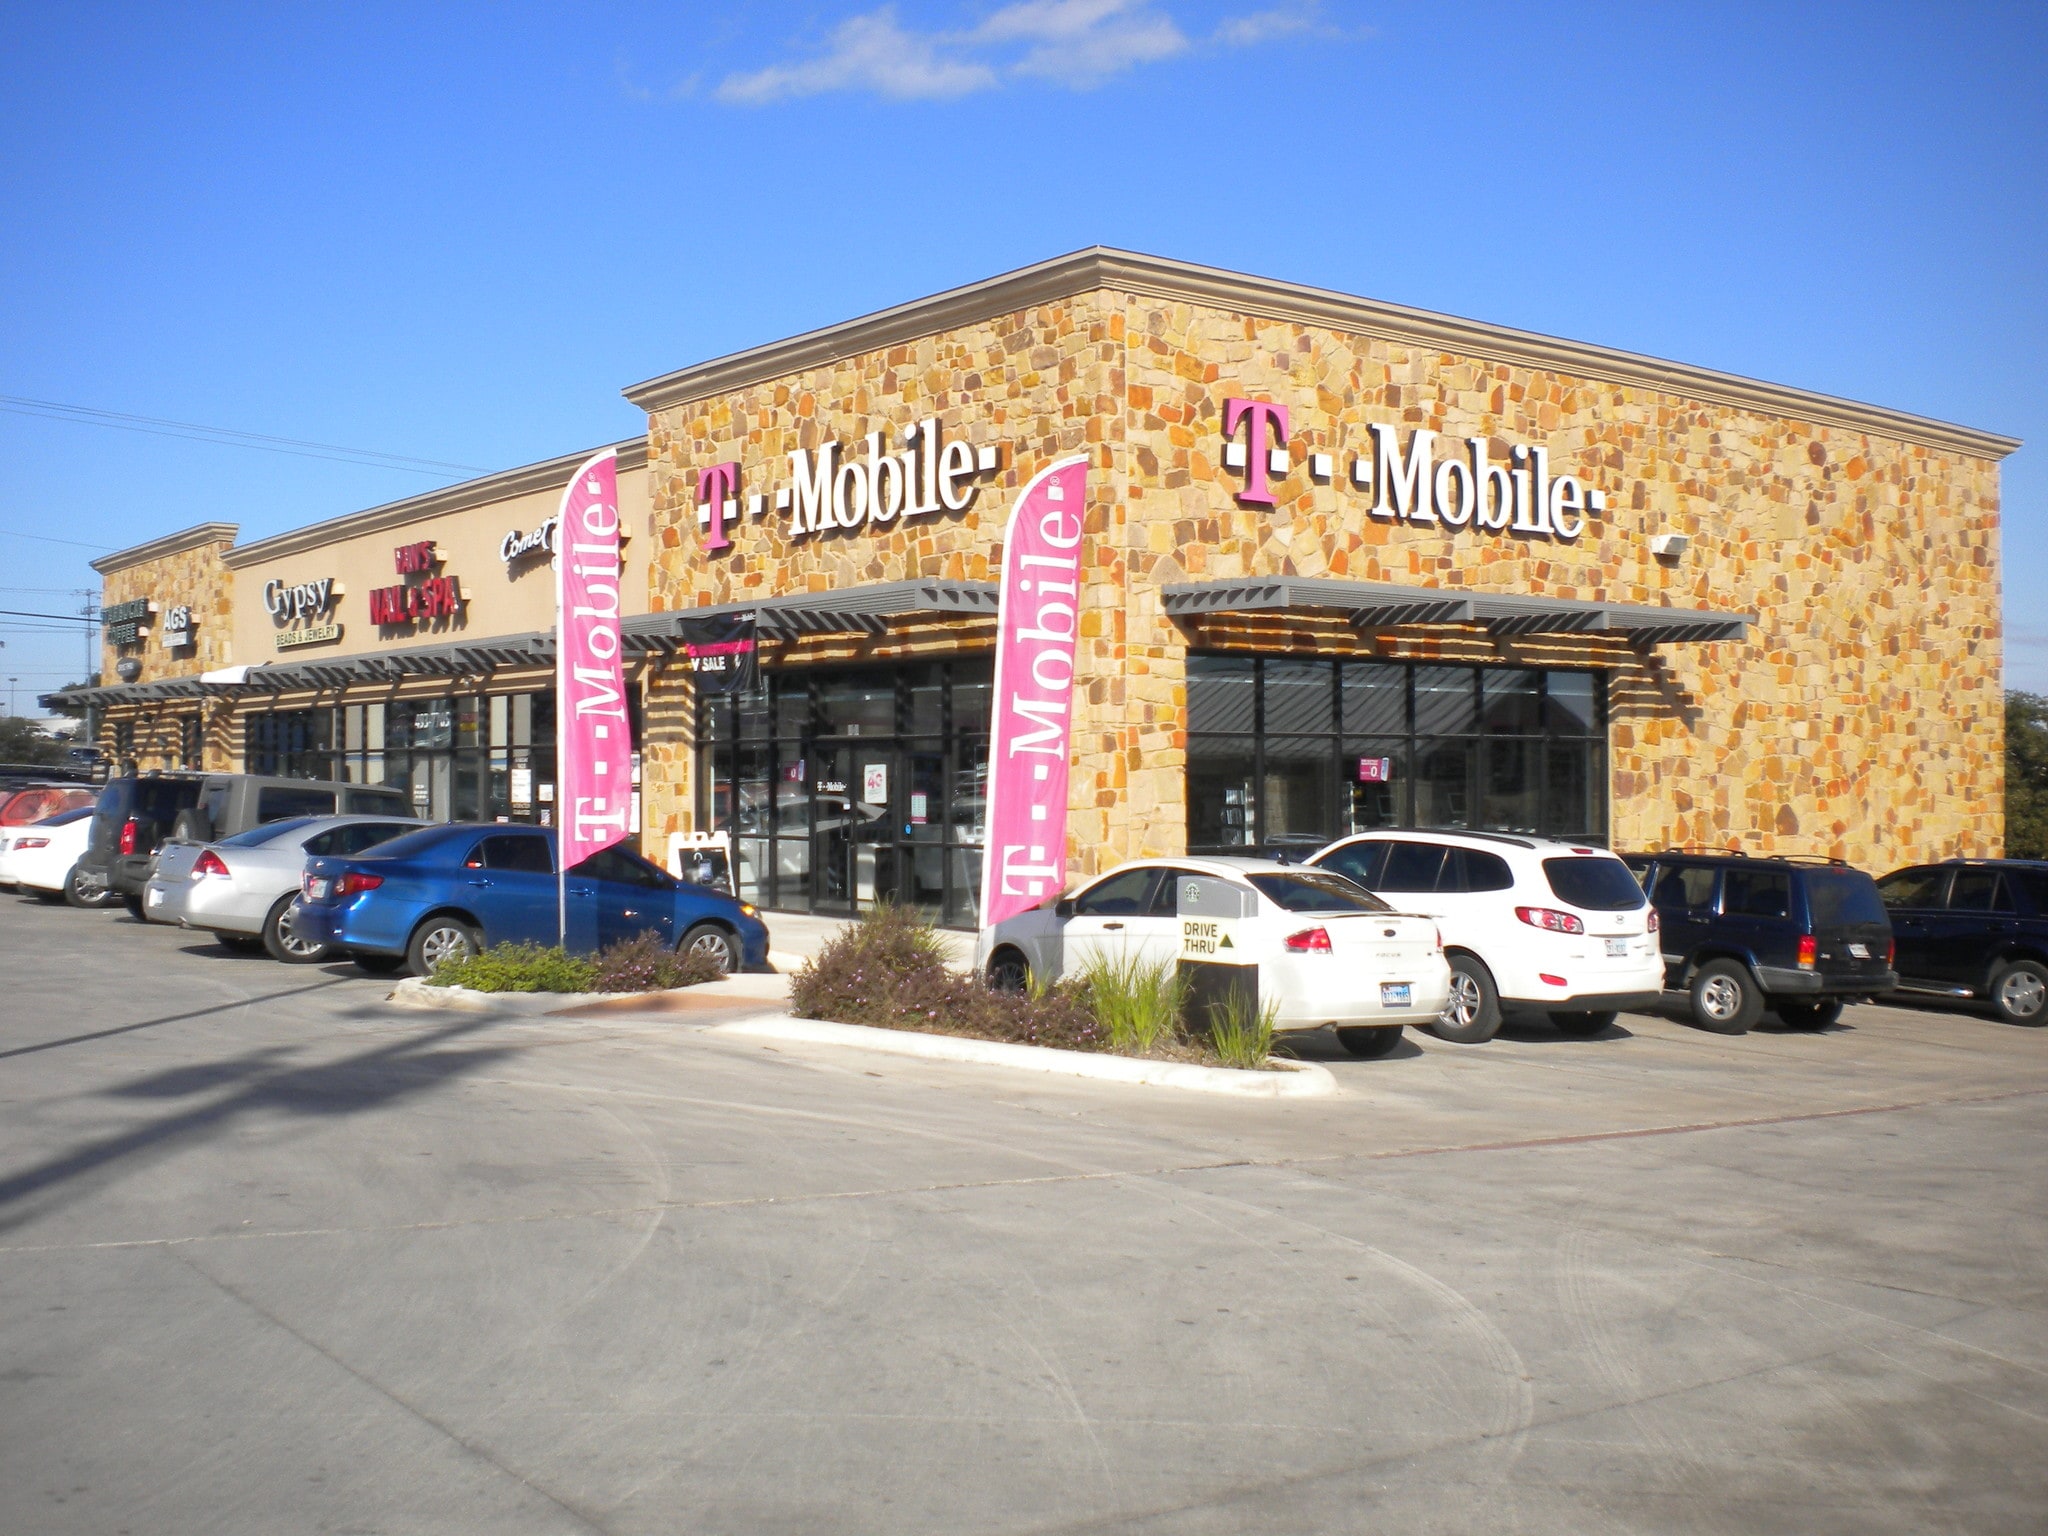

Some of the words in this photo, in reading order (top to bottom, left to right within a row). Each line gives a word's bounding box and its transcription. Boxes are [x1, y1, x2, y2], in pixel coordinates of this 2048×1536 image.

[263, 578, 329, 621] Gypsy
[421, 576, 457, 618] SPA
[163, 605, 188, 632] AGS
[276, 631, 297, 646] BEADS
[305, 626, 336, 641] JEWELRY
[702, 655, 727, 672] SALE
[1184, 922, 1218, 938] DRIVE
[1184, 938, 1216, 954] THRU
